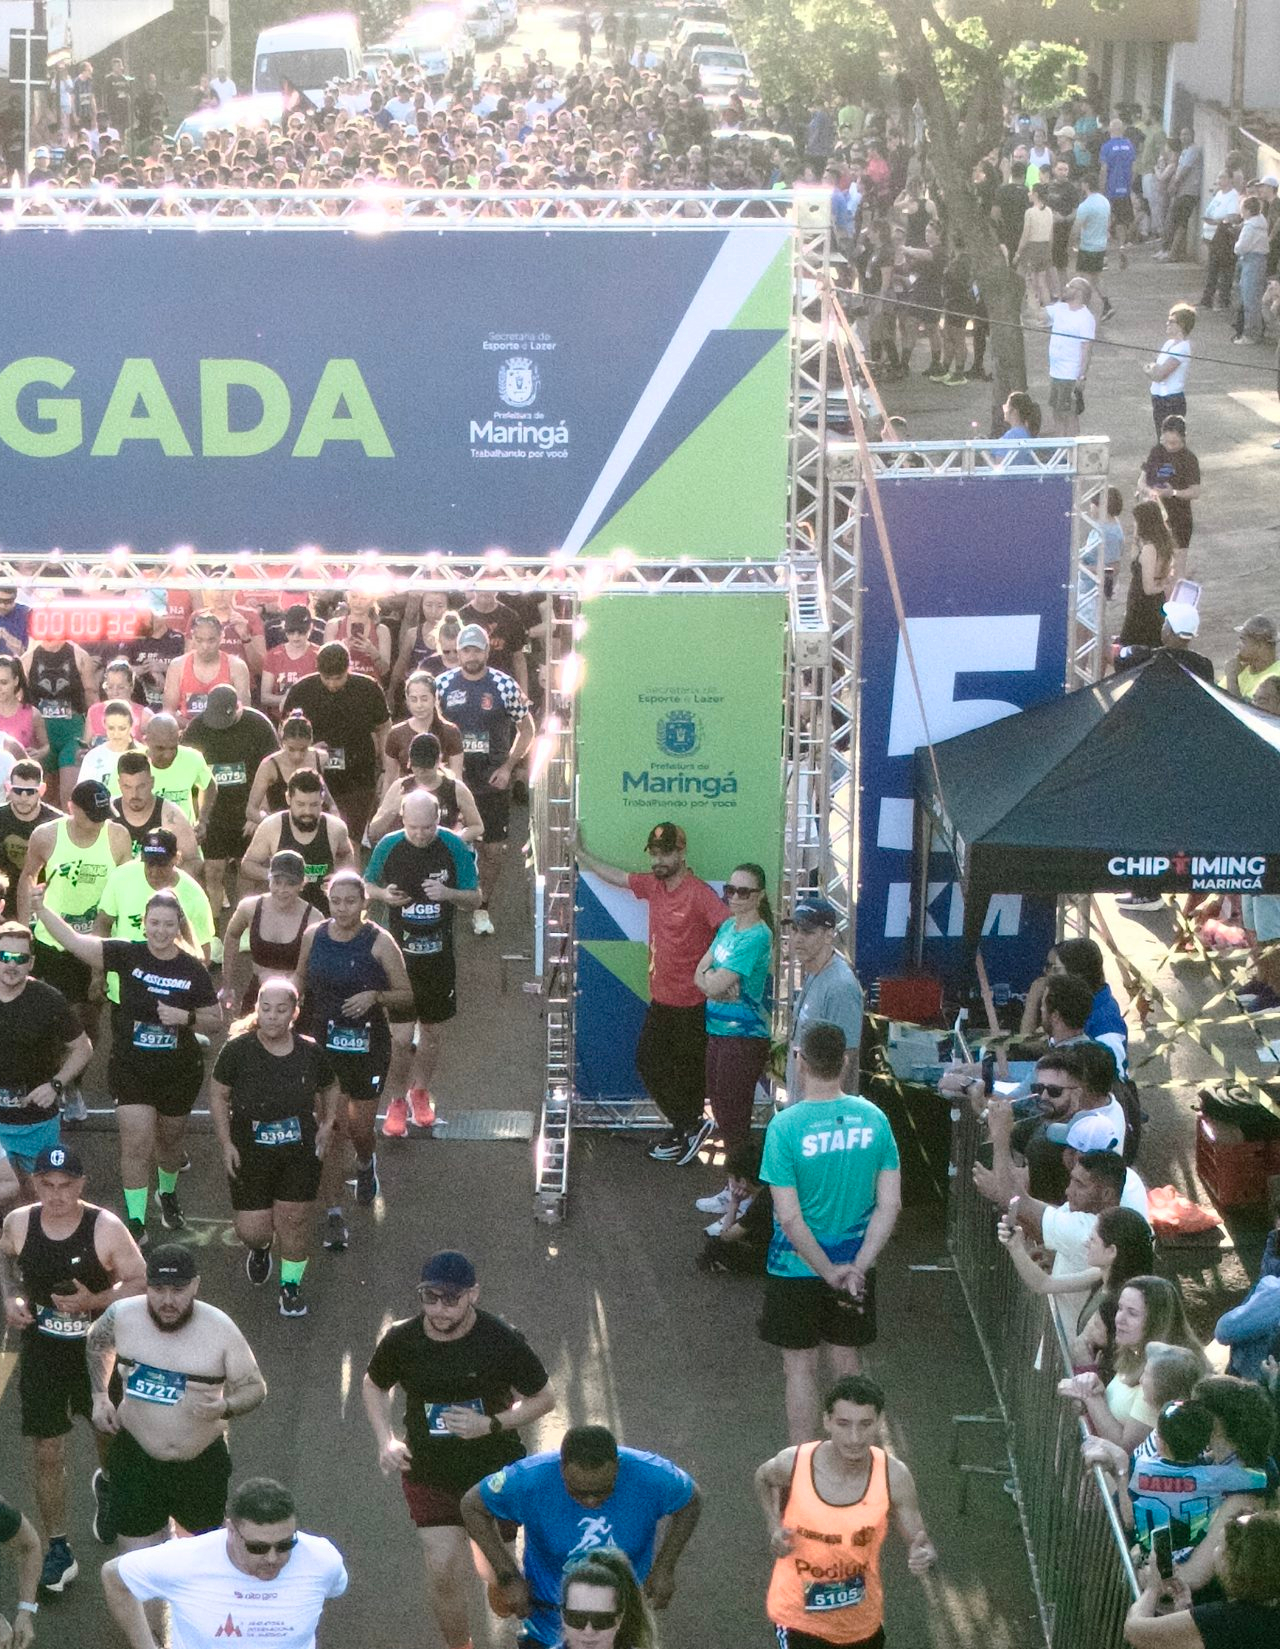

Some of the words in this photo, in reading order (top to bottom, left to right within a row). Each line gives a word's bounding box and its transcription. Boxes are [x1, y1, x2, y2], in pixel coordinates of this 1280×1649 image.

[482, 341, 519, 351] Esporte
[530, 341, 557, 351] Lazer
[470, 420, 569, 449] Maringá
[470, 448, 526, 458] Trabalhando
[528, 452, 543, 460] por
[546, 449, 569, 458] você
[639, 693, 681, 704] Esporte
[694, 694, 724, 704] Lazer
[622, 770, 738, 800] Maringá
[623, 798, 687, 808] Trabalhando
[690, 800, 709, 809] por
[1107, 856, 1170, 876] CHIP
[1192, 877, 1263, 890] MARINGÁ
[415, 903, 442, 915] GBS
[140, 1033, 171, 1045] 5977
[333, 1036, 364, 1048] 6049
[260, 1130, 293, 1143] 5394
[802, 1127, 873, 1157] STAFF
[44, 1318, 83, 1332] 6059
[135, 1381, 177, 1397] 5727
[815, 1588, 858, 1606] 5105
